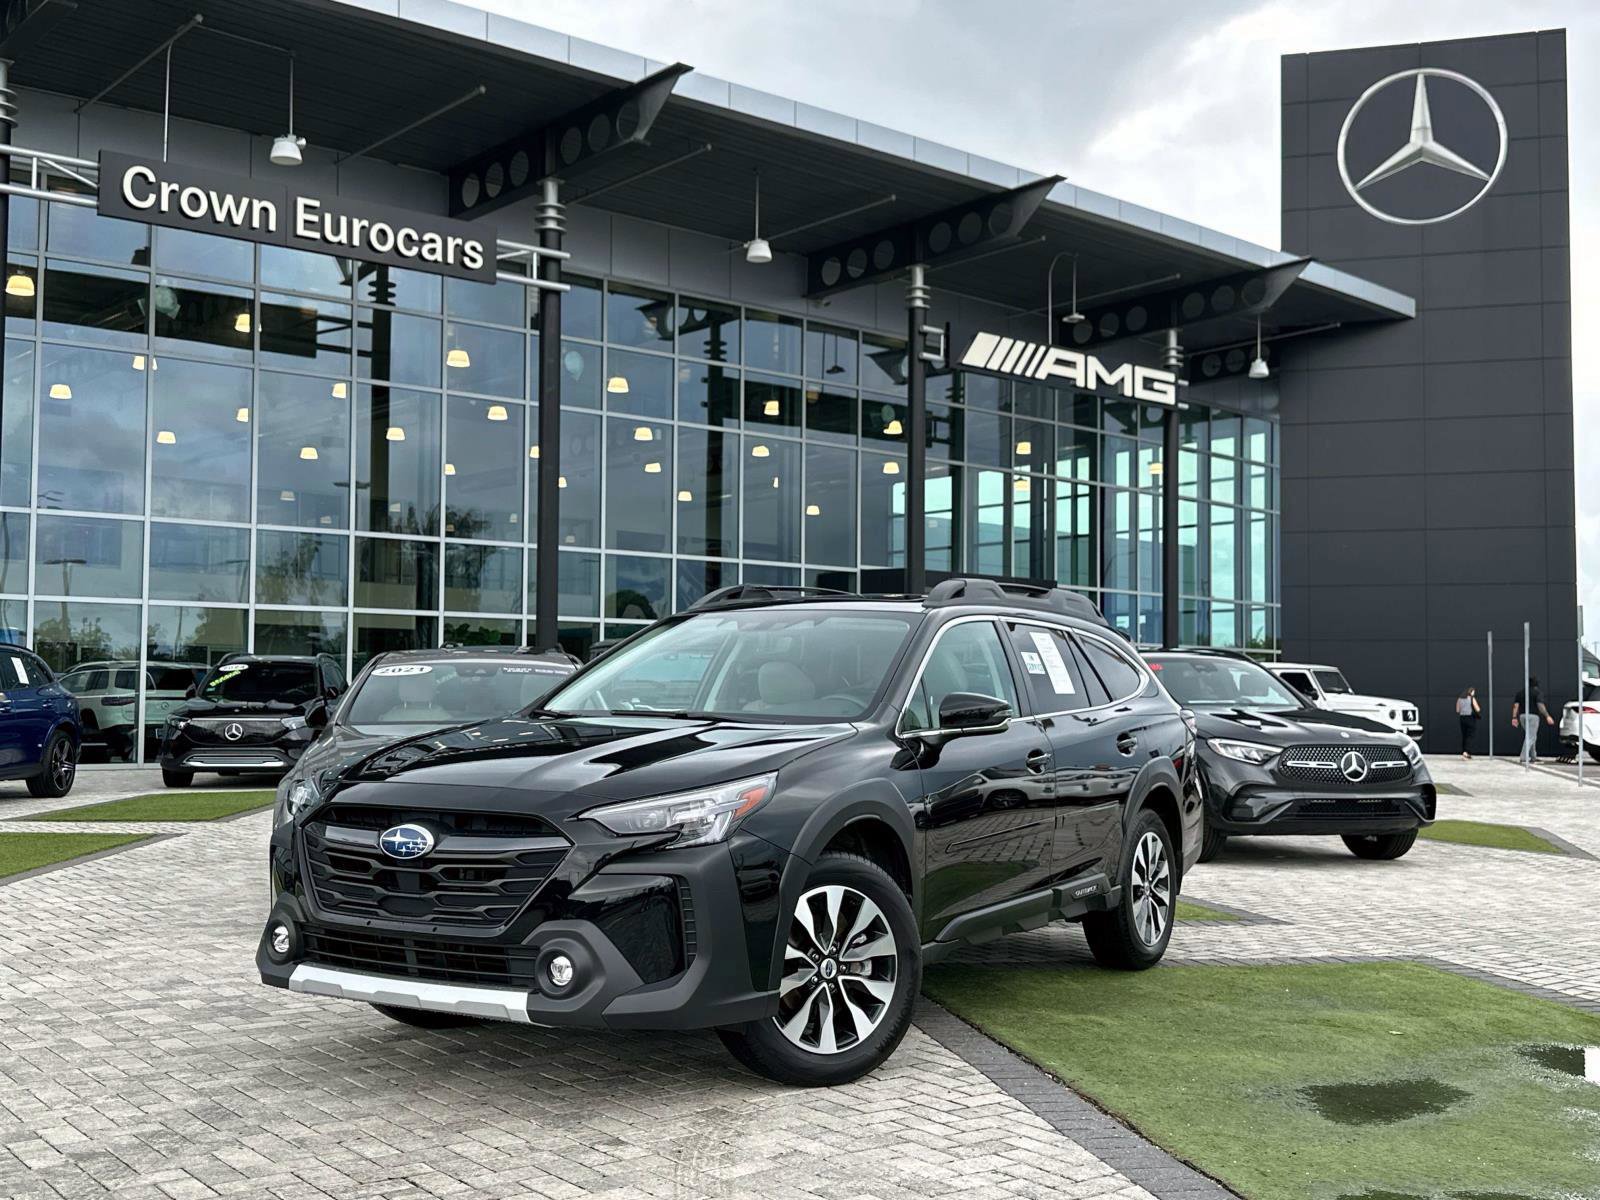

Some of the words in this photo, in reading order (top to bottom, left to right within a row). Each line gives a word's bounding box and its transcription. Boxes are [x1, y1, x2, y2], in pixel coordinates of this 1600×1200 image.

[122, 165, 278, 232] Crown
[296, 196, 484, 270] Eurocars
[1034, 347, 1176, 405] AMG
[379, 666, 426, 674] 2021
